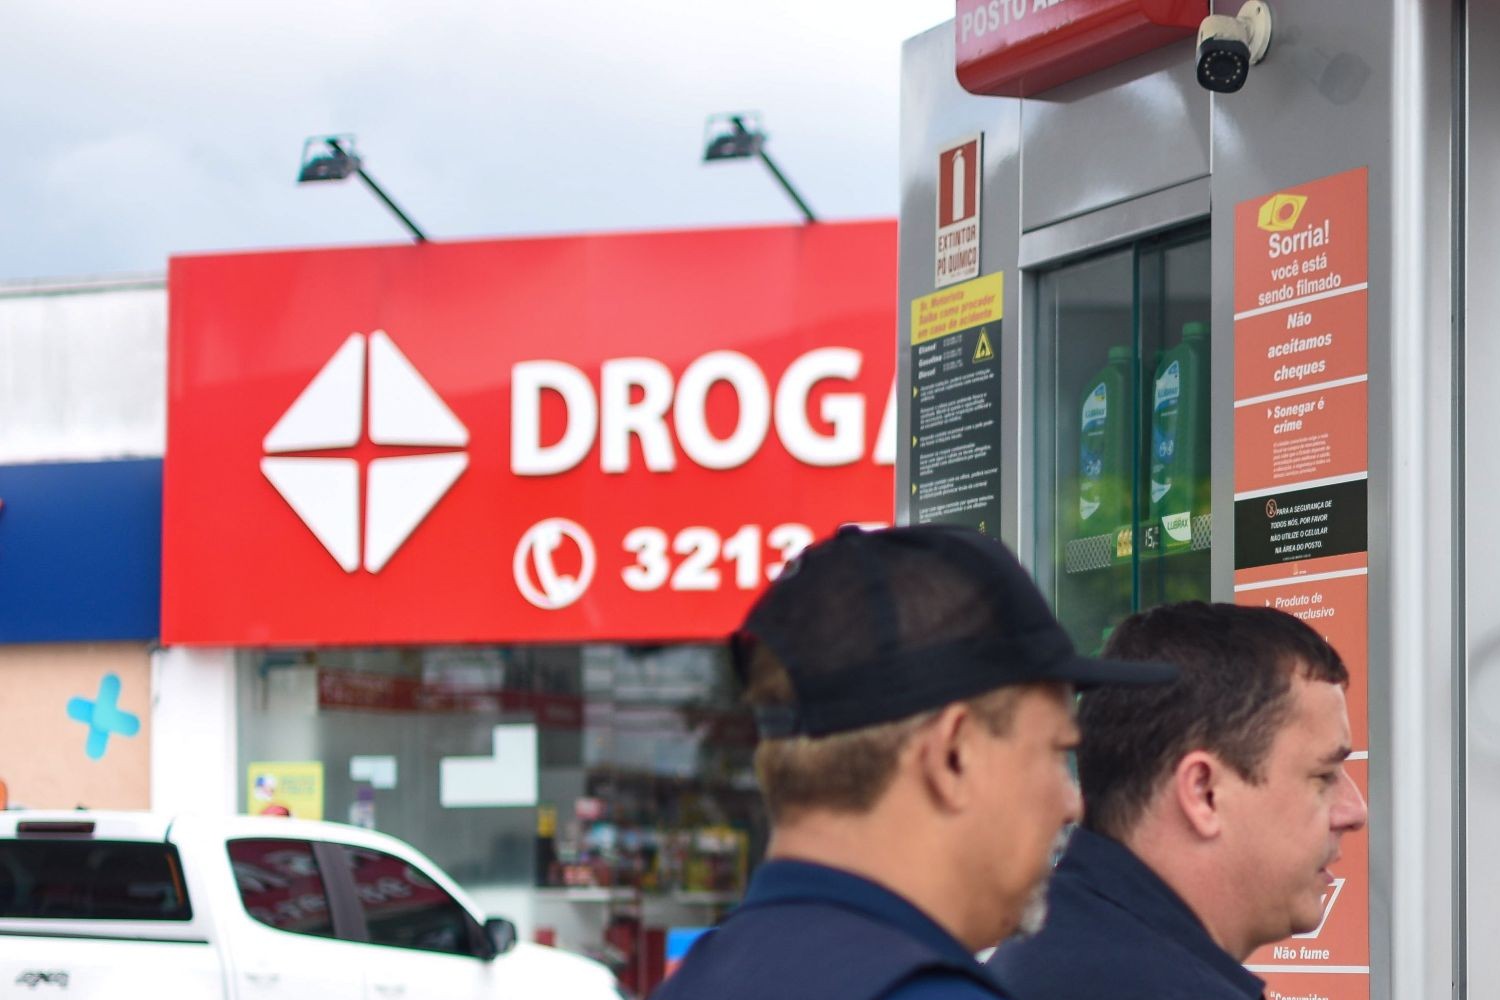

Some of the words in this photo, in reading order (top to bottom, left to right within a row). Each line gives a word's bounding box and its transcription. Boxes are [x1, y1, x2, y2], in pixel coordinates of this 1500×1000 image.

[961, 0, 1026, 43] POSTO
[938, 225, 976, 253] EXTINTOR
[1269, 219, 1330, 258] Sorria!
[948, 247, 977, 273] QUÍMICO
[1271, 259, 1298, 281] você
[1302, 252, 1327, 273] está
[1258, 285, 1293, 306] sendo
[1297, 273, 1342, 296] filmado
[1287, 312, 1312, 330] Não
[1267, 332, 1332, 359] aceitamos
[1274, 359, 1326, 381] cheques
[510, 347, 897, 476] DROG
[1274, 401, 1316, 418] Sonegar
[1317, 396, 1325, 410] é
[1273, 419, 1303, 434] crime
[1167, 517, 1189, 531] LUBRAX
[1299, 516, 1311, 525] POR
[1310, 514, 1328, 523] FAVOR
[1275, 595, 1310, 608] Produto
[1311, 592, 1322, 603] de
[1293, 606, 1335, 620] exclusivo
[1273, 946, 1296, 959] Não
[1300, 946, 1330, 959] fume
